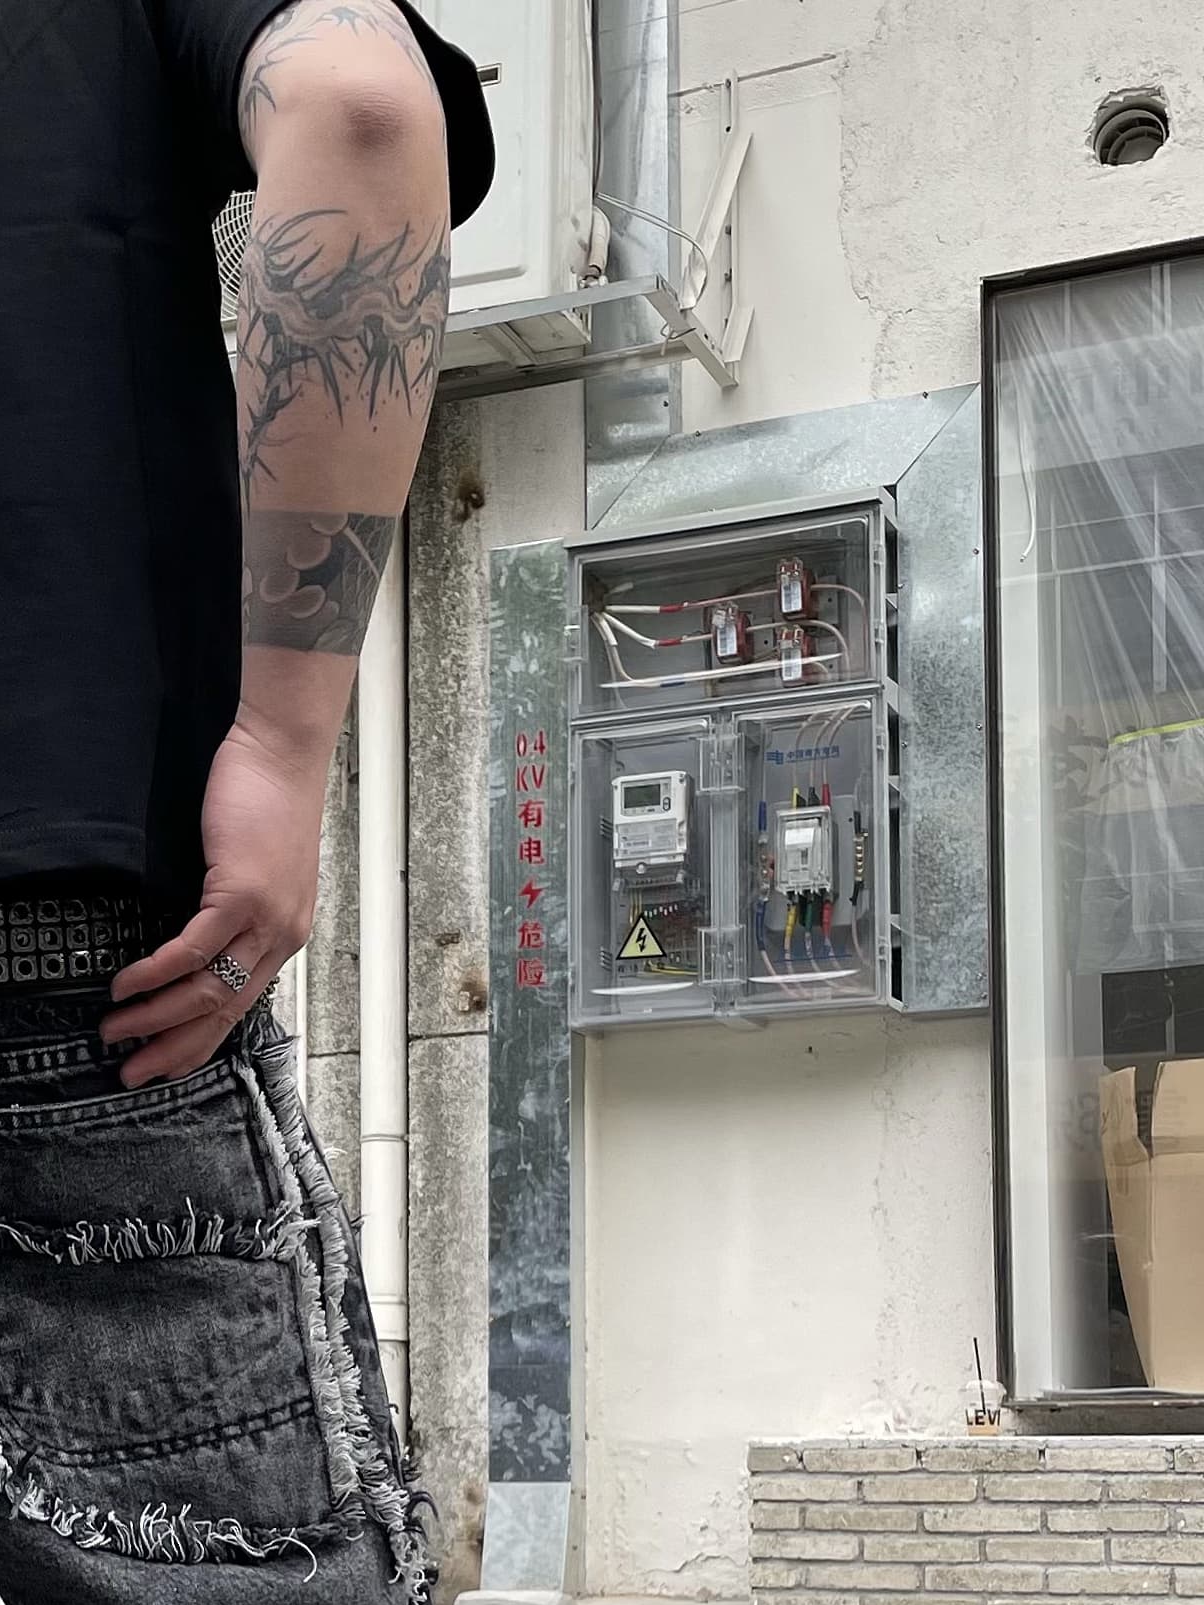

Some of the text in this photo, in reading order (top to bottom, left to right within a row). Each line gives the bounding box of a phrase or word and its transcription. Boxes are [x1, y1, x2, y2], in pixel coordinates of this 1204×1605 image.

[516, 765, 545, 792] KV
[518, 799, 544, 865] 有电
[517, 921, 545, 988] 危险
